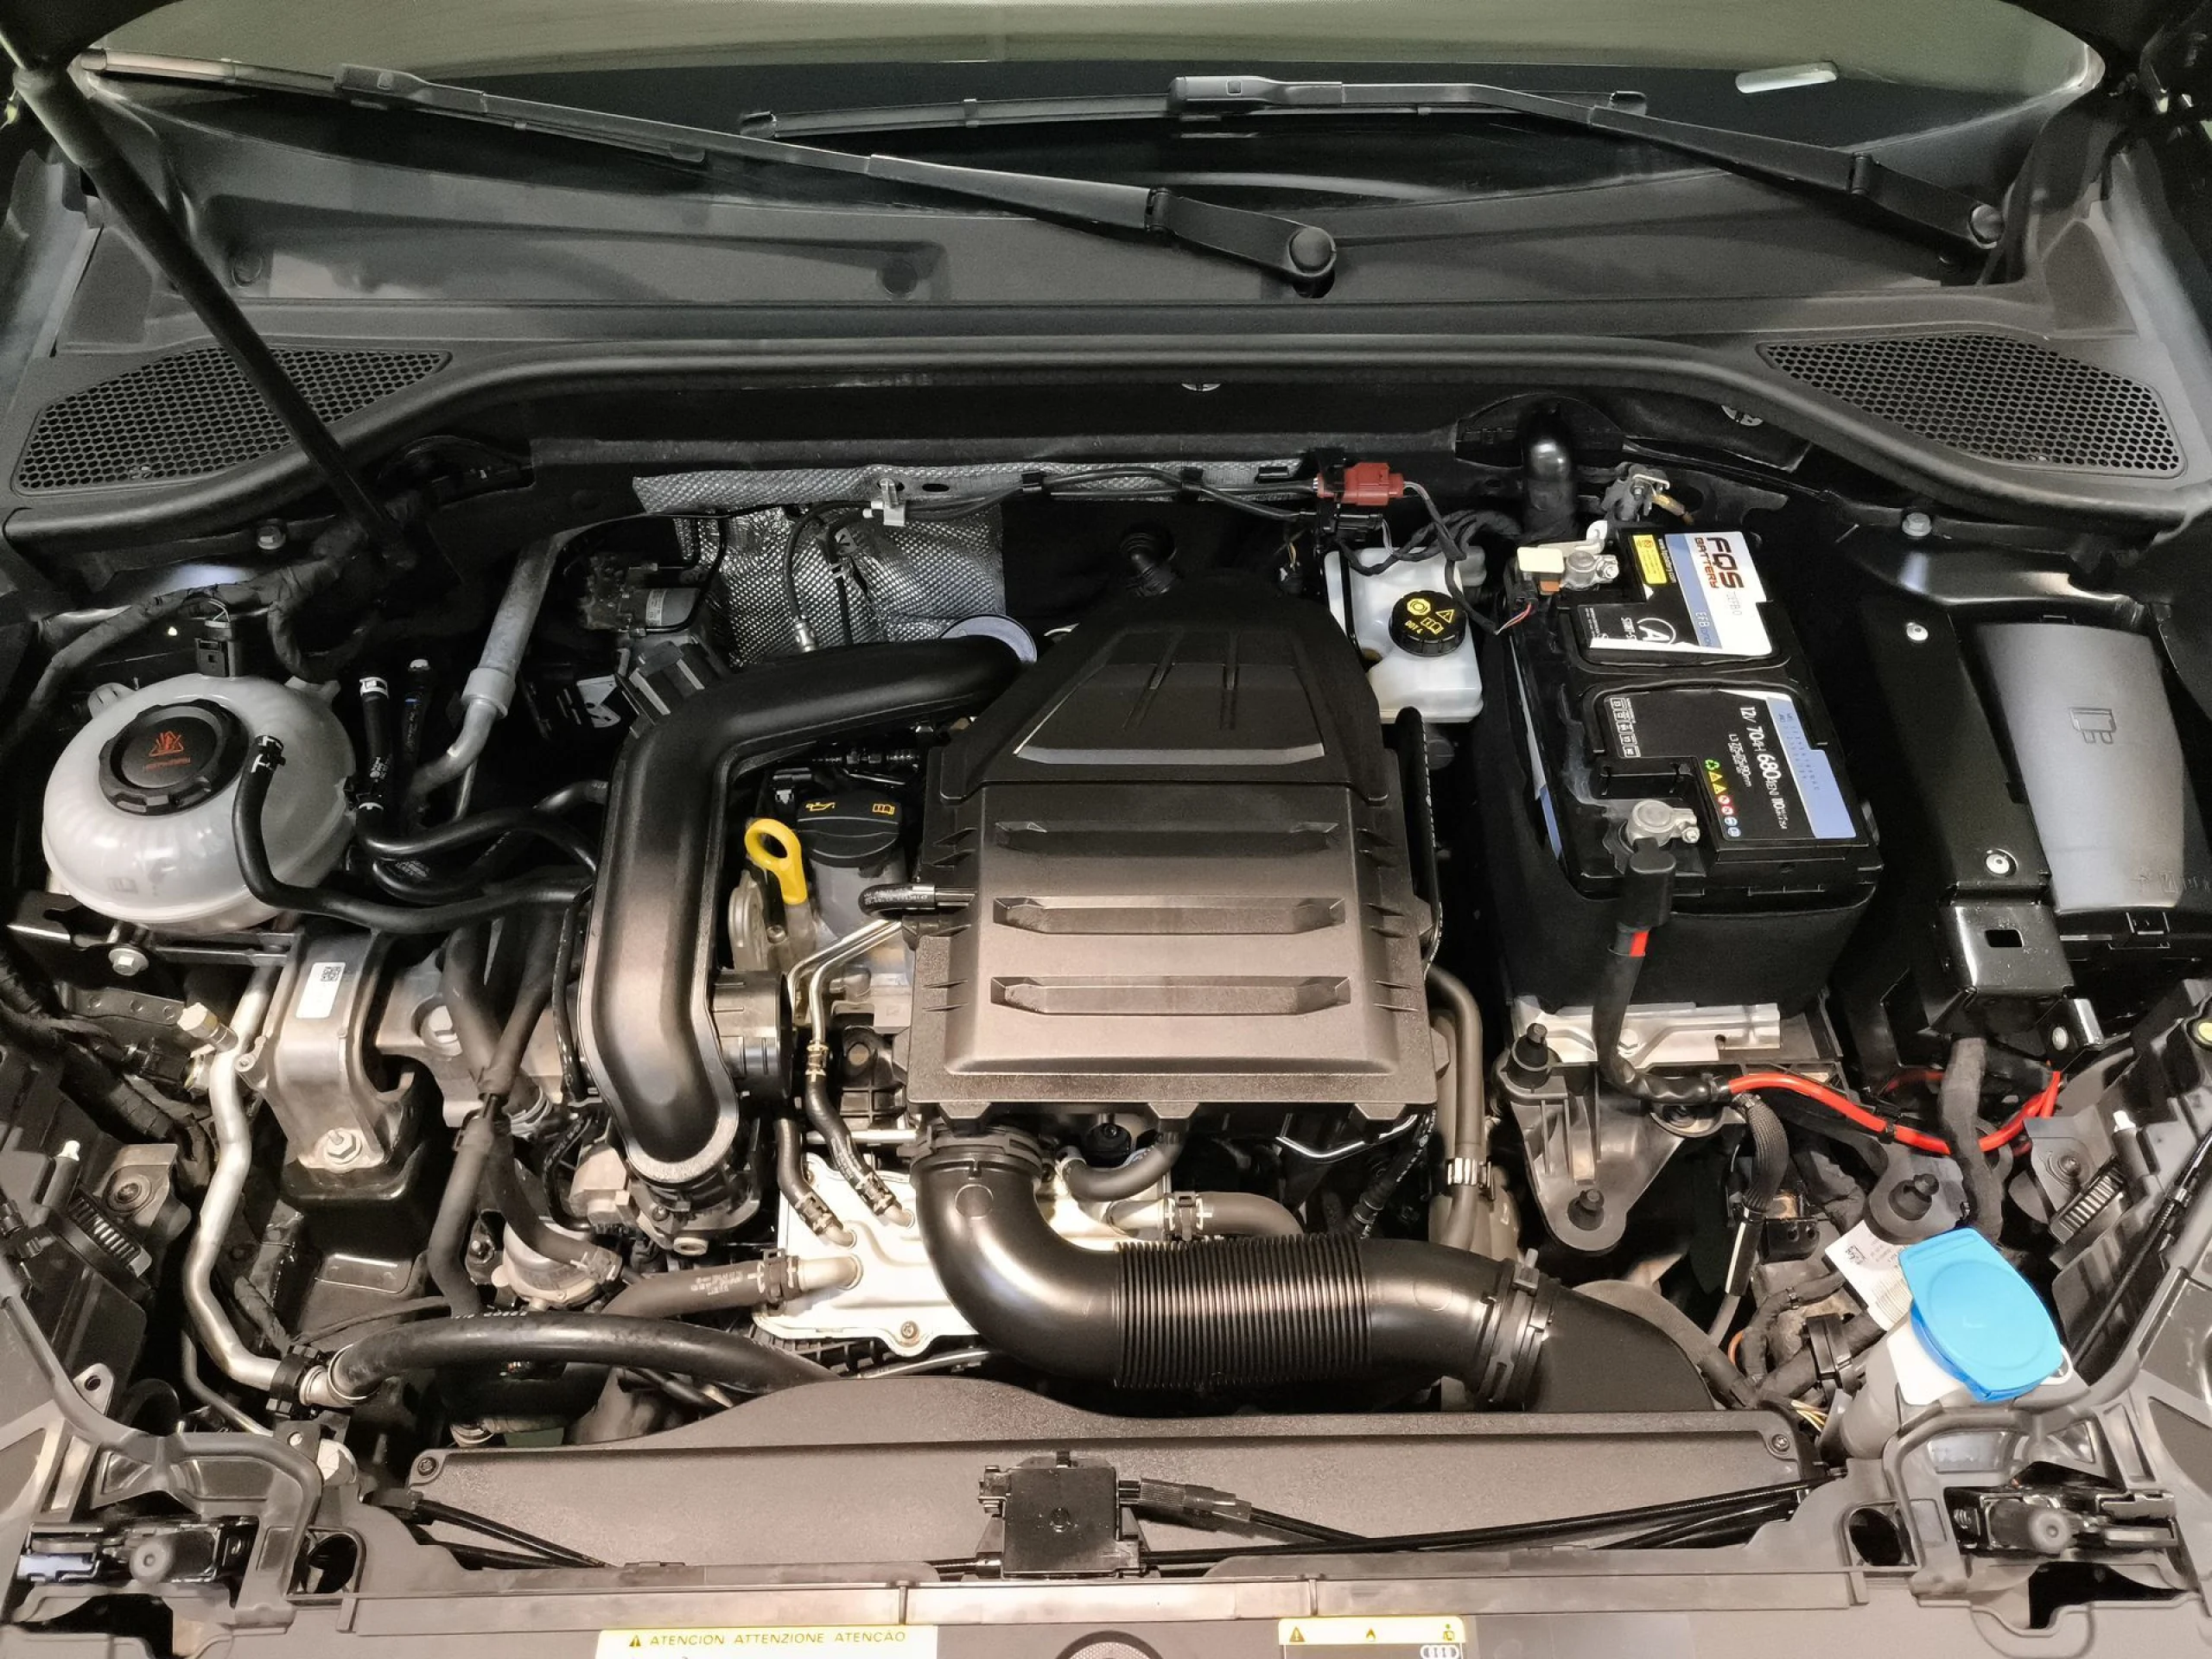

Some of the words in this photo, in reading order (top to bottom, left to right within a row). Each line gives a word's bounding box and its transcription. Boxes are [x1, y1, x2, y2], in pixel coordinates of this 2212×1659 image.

[1694, 537, 1719, 588] BATTERY
[1706, 537, 1745, 588] FQS
[734, 1633, 825, 1644] ATTENZIONE
